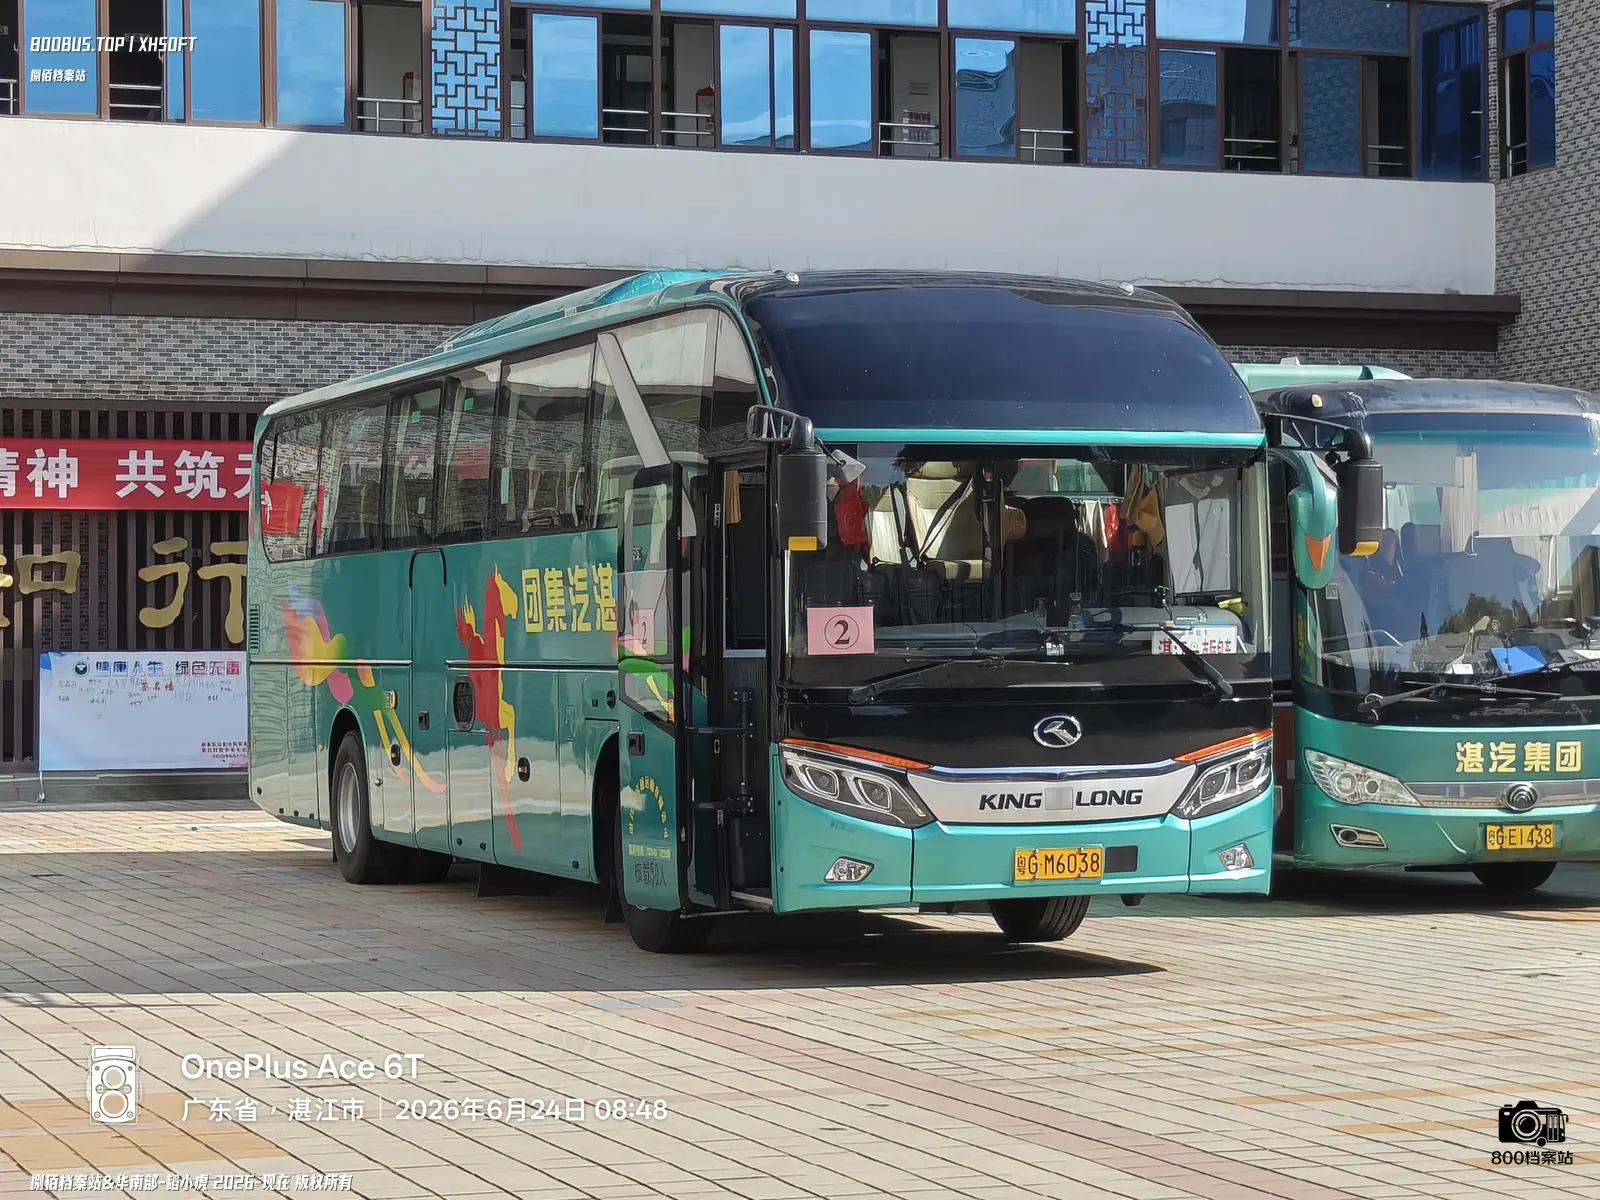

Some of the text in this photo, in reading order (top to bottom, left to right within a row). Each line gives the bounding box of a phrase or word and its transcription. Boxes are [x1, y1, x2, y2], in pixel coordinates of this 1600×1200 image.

[1455, 741, 1582, 773] 湛汽集团
[979, 789, 1143, 811] KING LONG
